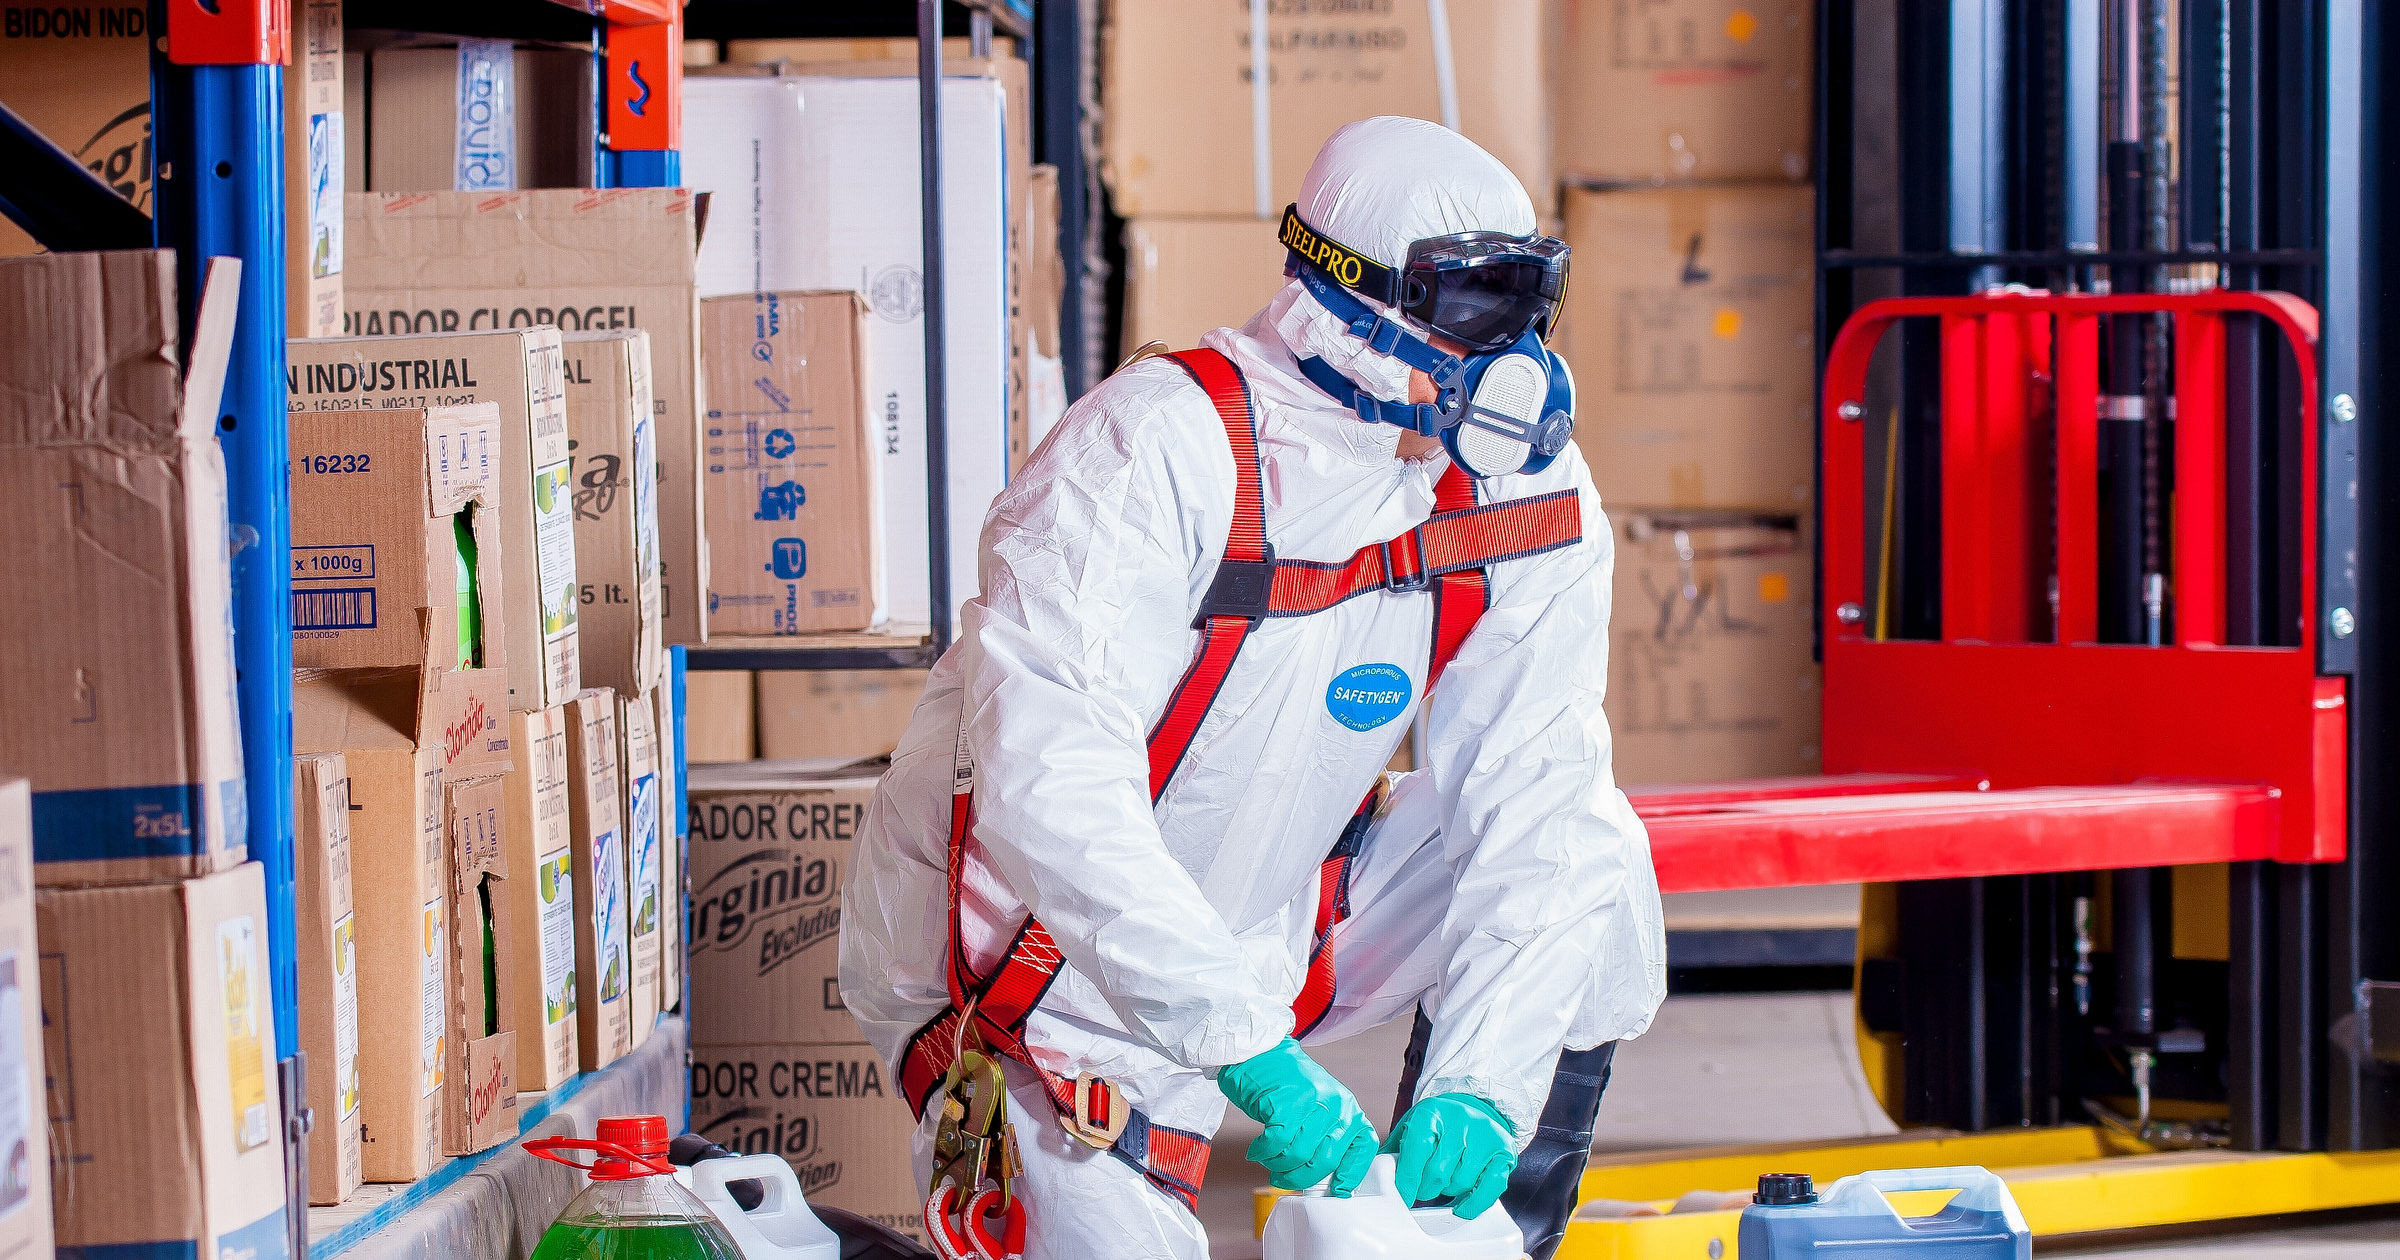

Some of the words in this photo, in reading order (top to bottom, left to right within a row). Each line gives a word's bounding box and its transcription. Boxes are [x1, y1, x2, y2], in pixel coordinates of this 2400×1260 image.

[5, 8, 91, 38] BIDON
[100, 8, 149, 38] IND
[1283, 214, 1362, 287] STEELPRO
[306, 357, 477, 394] INDUSTRIAL
[300, 453, 371, 475] 16232
[294, 560, 305, 571] x
[310, 556, 363, 573] 1000g
[580, 584, 595, 605] 5
[605, 583, 629, 604] lt.
[1350, 667, 1402, 681] MICROPOROUS
[1334, 686, 1401, 705] SAFETYGEN
[445, 690, 485, 764] Clorinda
[1338, 712, 1387, 729] TECHNOLOGY
[689, 803, 778, 842] ADOR
[691, 1062, 759, 1098] DOR
[769, 1061, 883, 1098] CREMA
